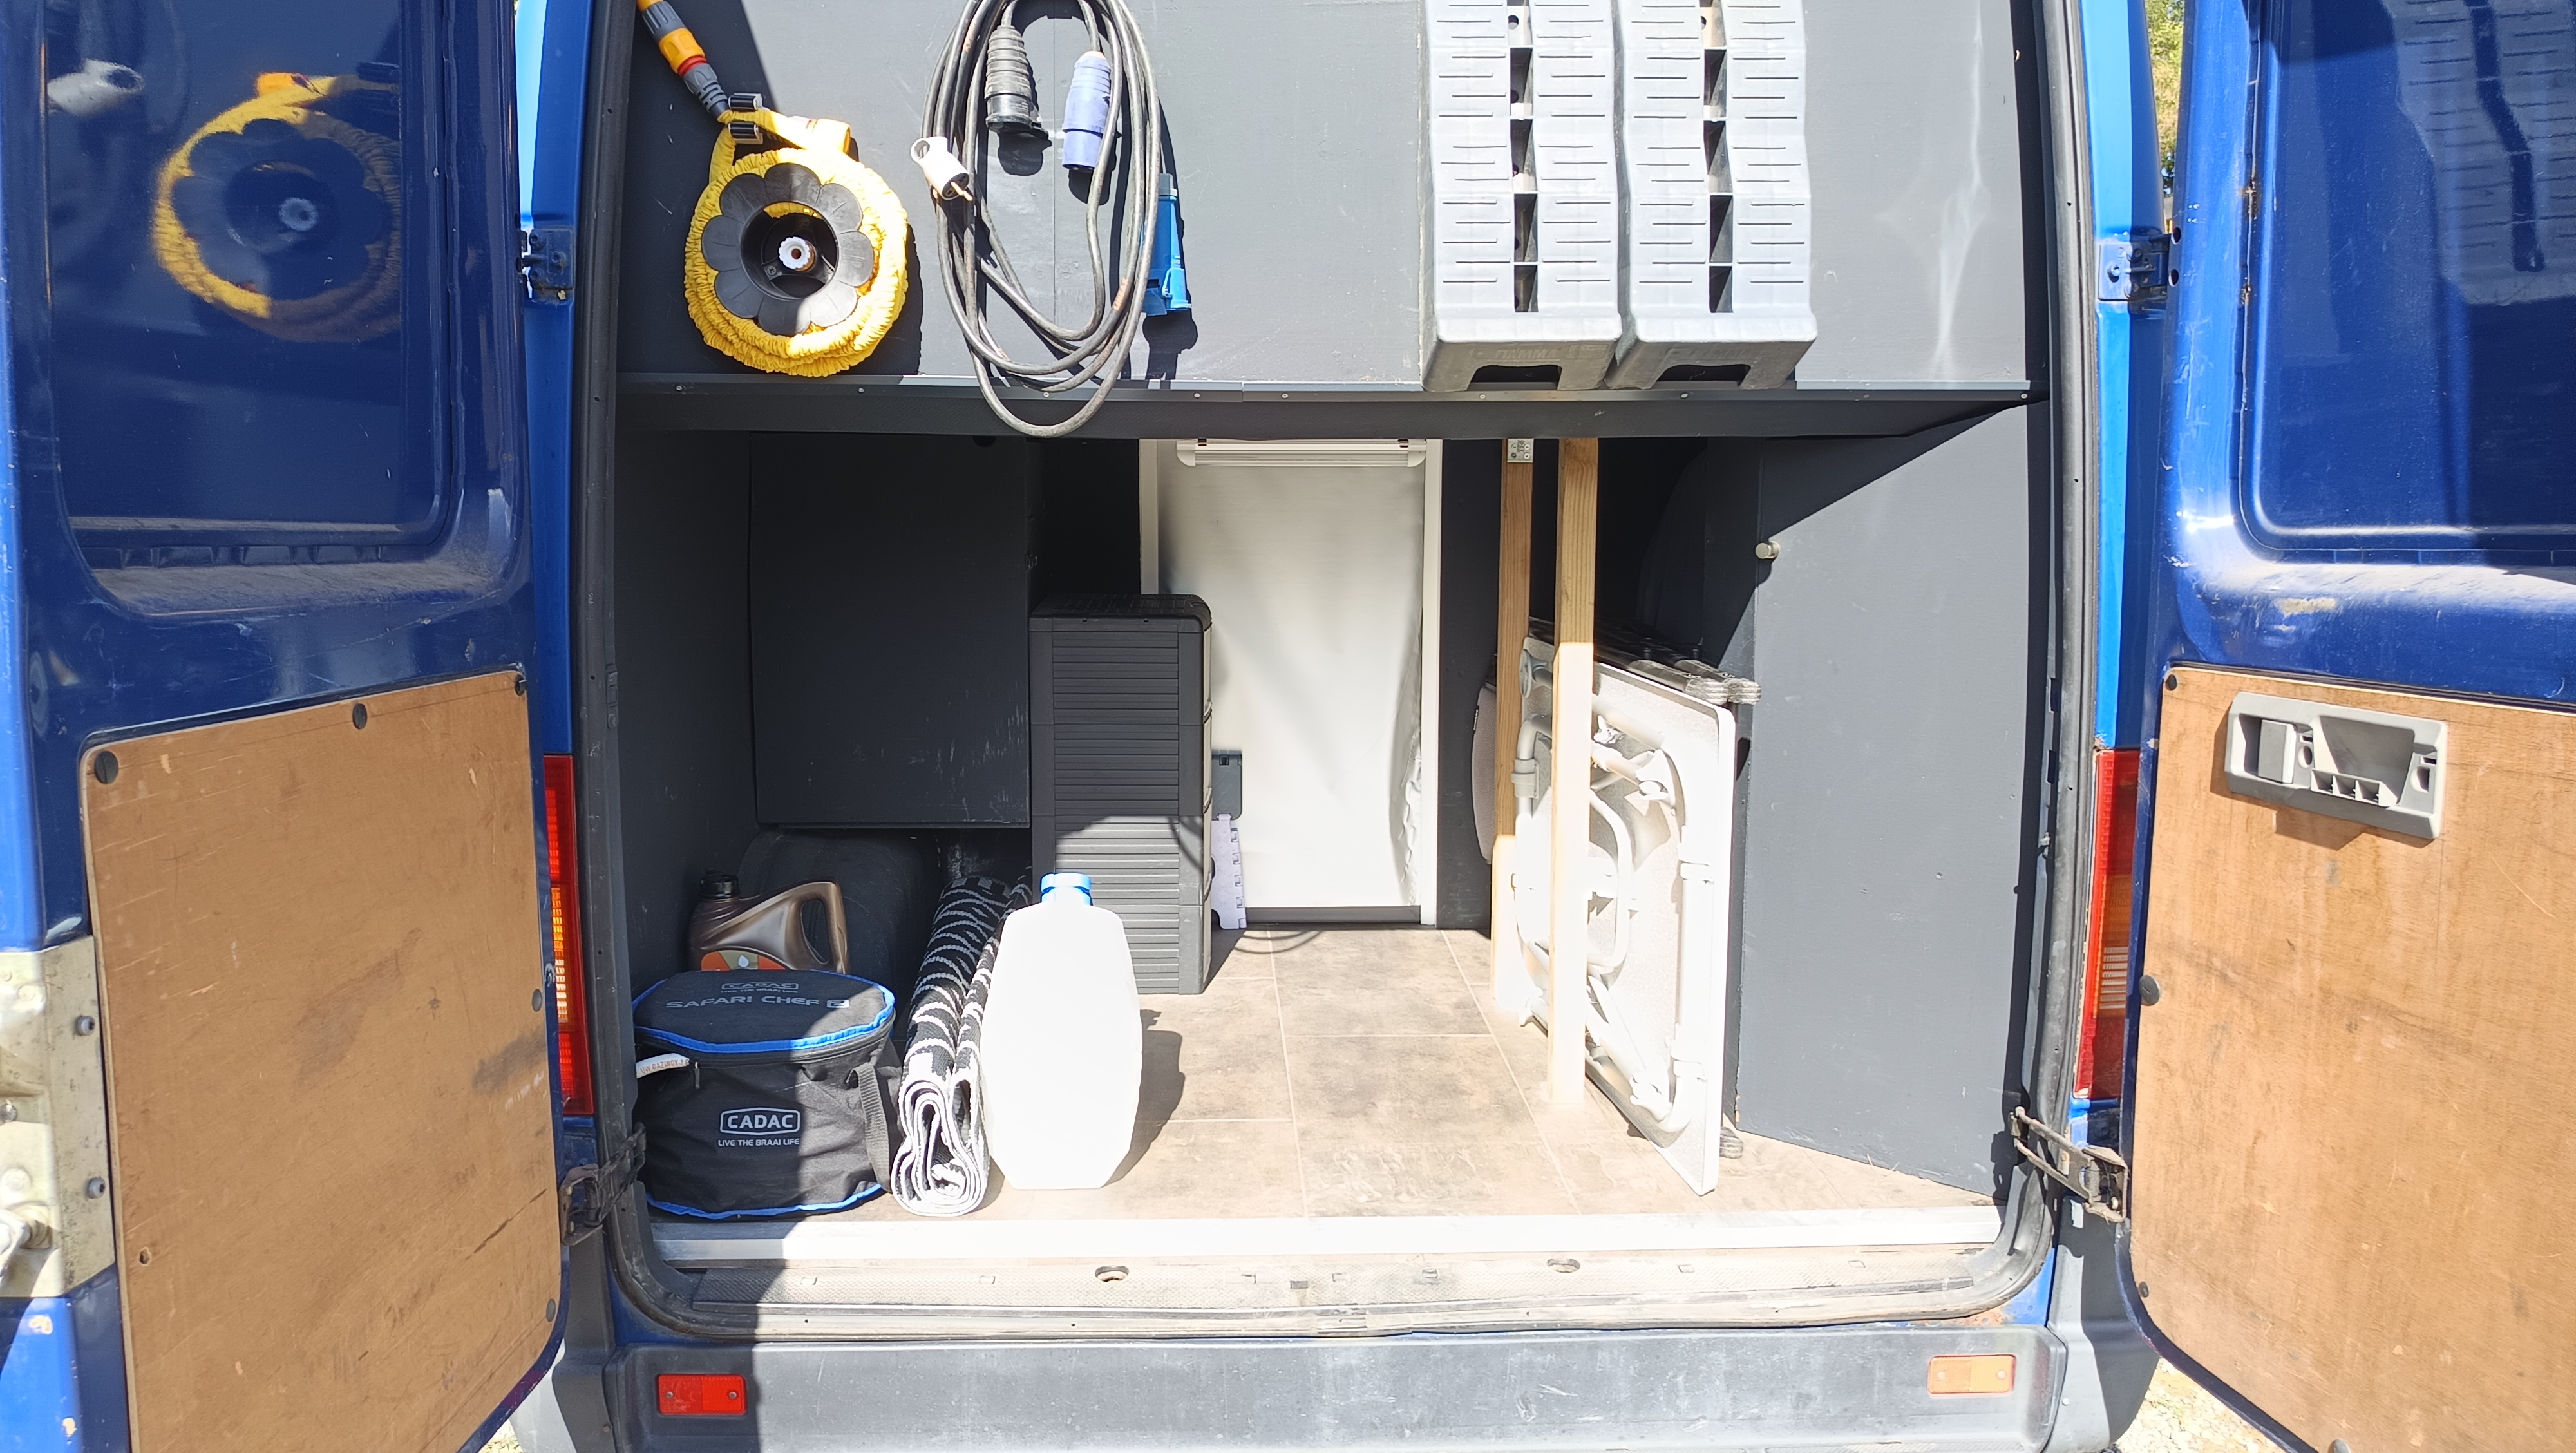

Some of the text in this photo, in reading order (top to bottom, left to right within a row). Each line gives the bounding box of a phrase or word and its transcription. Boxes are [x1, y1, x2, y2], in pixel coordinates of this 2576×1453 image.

[1493, 348, 1557, 359] FIAMMA
[666, 996, 848, 1008] SAFARI CHEF 2
[727, 1114, 793, 1128] CADAC
